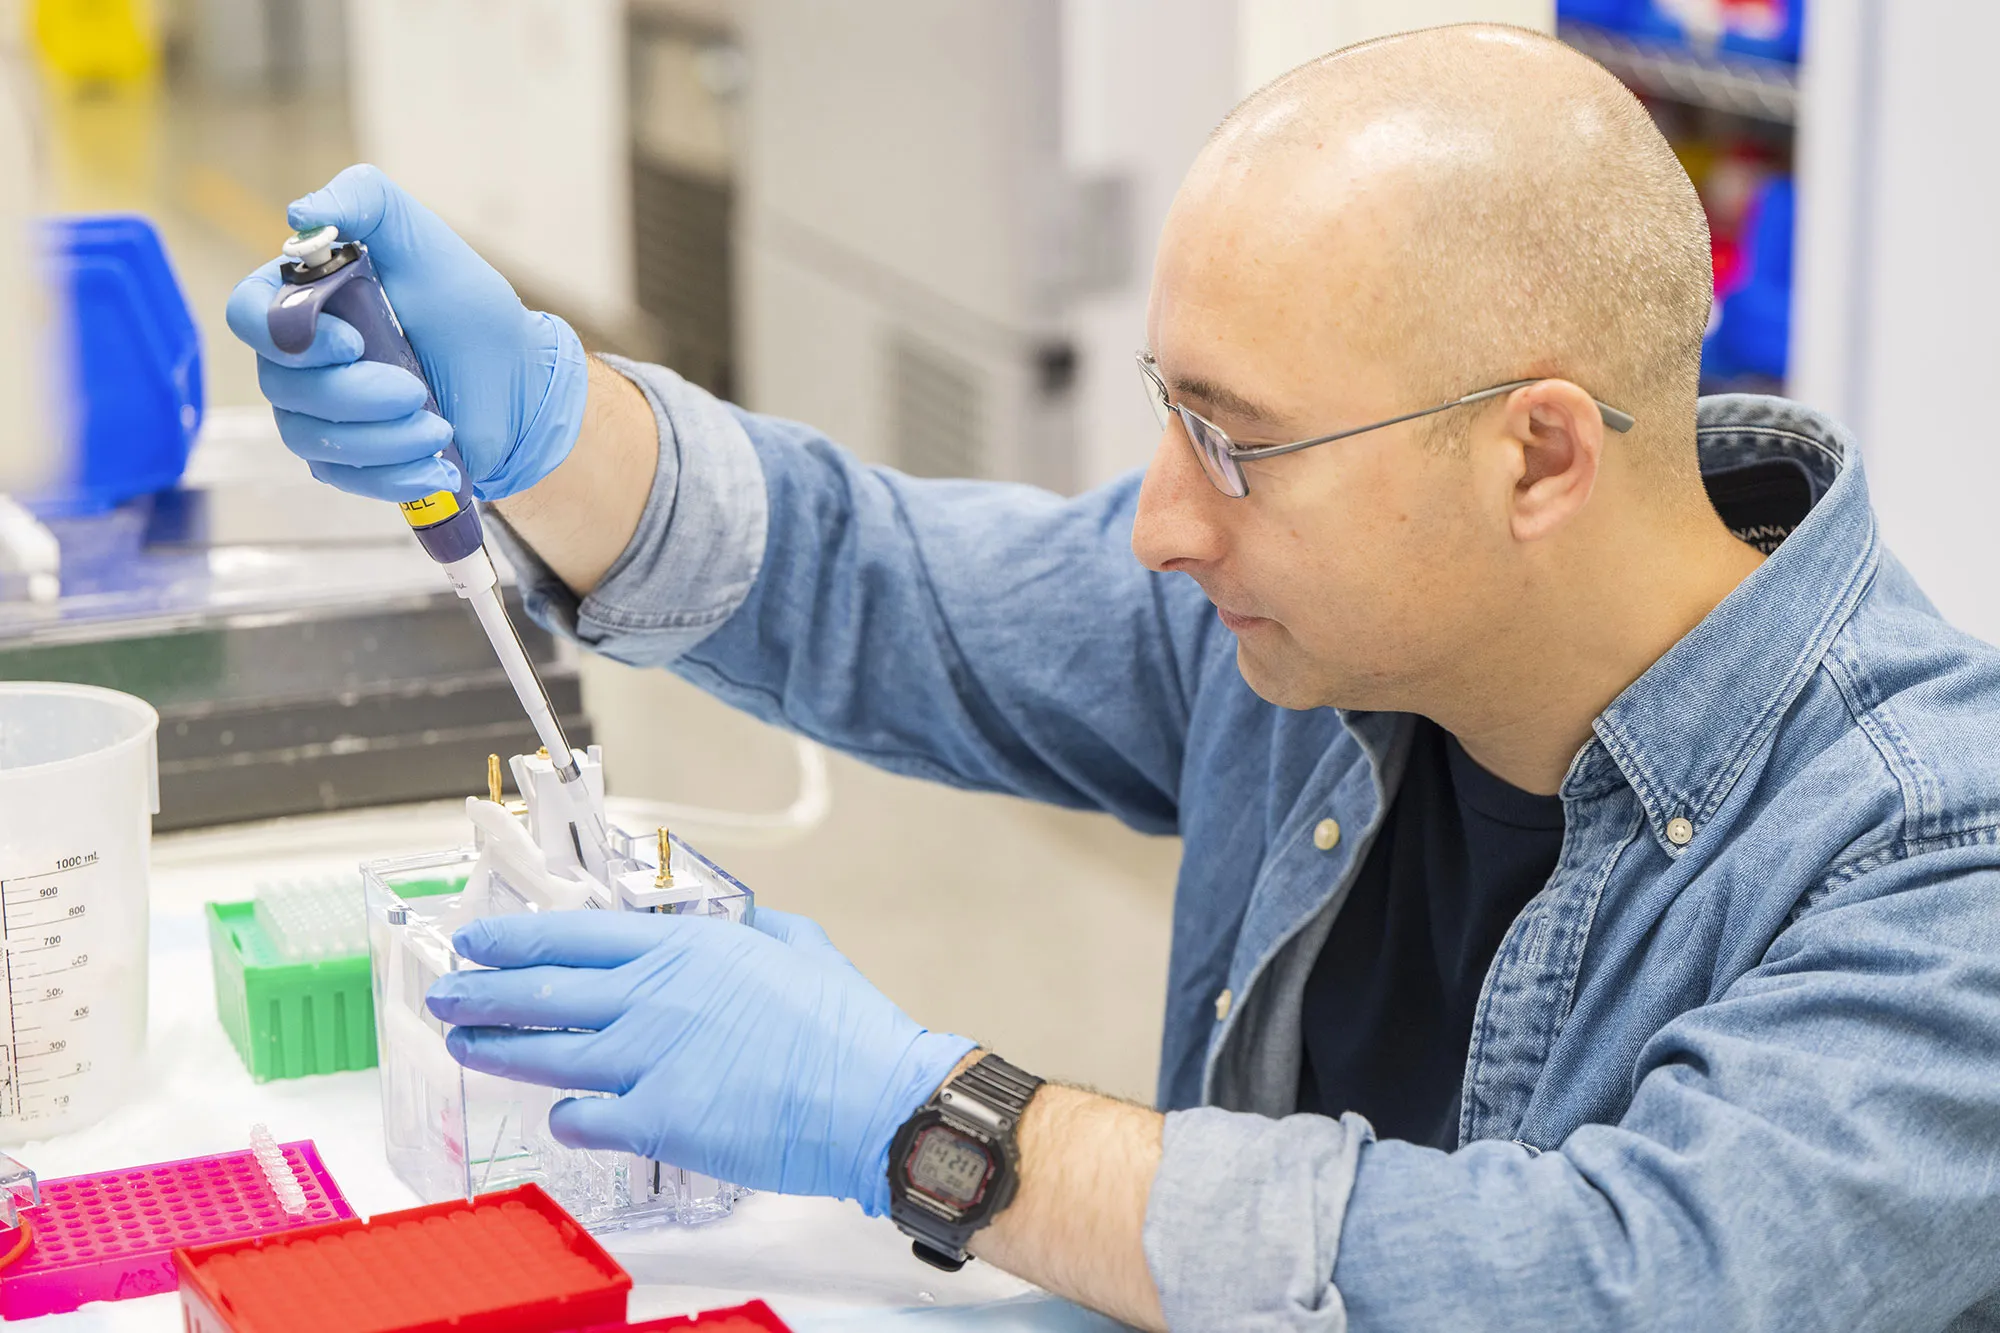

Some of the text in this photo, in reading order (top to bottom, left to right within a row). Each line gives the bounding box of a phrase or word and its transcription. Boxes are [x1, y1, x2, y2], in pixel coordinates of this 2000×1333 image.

[56, 855, 81, 869] 1000
[39, 886, 58, 897] 900
[68, 904, 86, 916] 800
[43, 935, 61, 946] 700
[49, 1040, 67, 1051] 300
